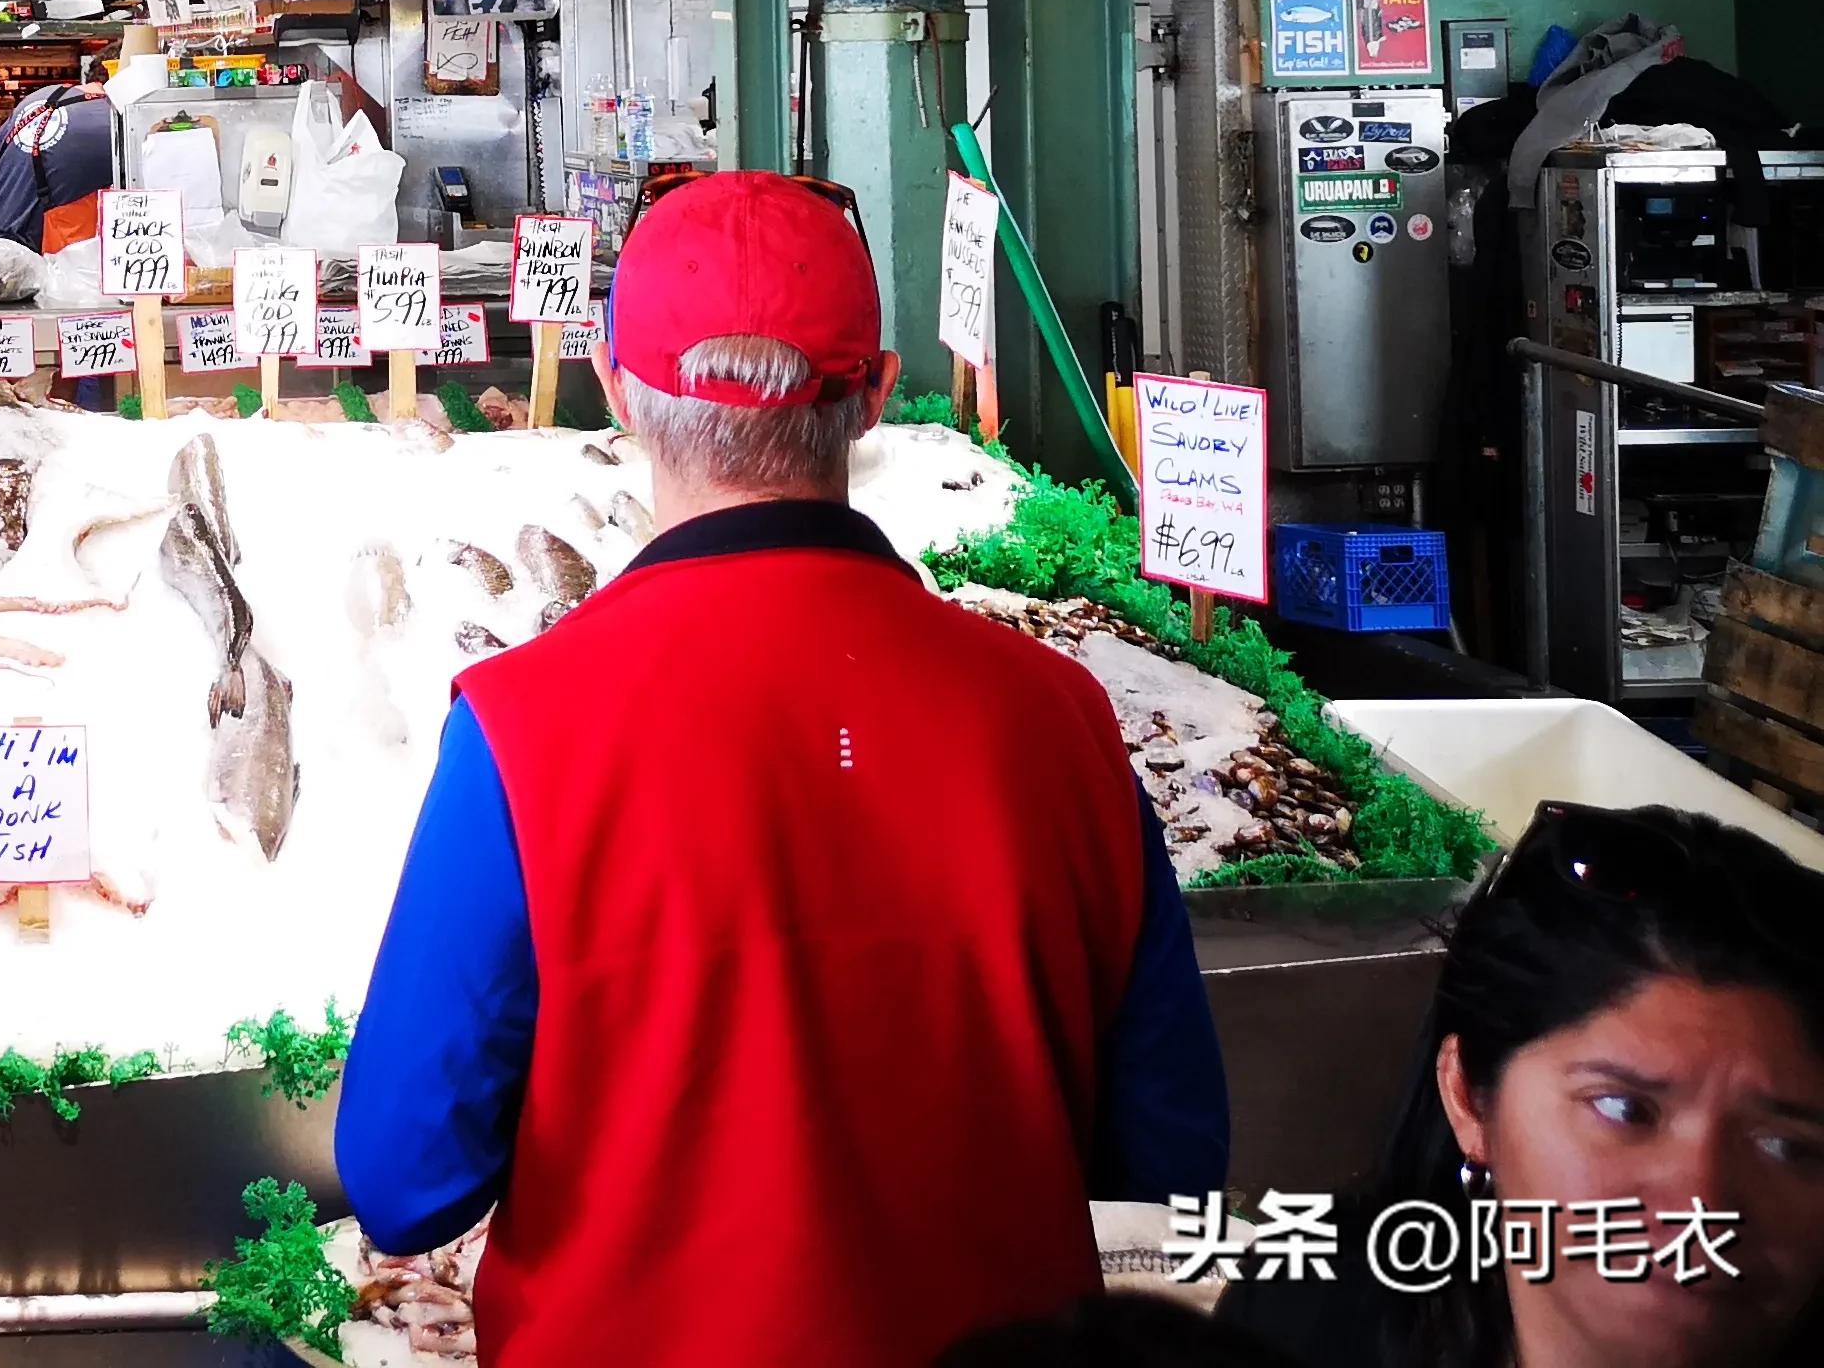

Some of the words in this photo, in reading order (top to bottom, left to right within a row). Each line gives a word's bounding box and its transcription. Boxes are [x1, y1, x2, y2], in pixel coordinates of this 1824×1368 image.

[1277, 29, 1344, 55] FISH
[1303, 178, 1374, 202] URUAPAN
[111, 218, 175, 240] BLACK
[125, 238, 163, 255] COD
[517, 231, 586, 260] RAINBOW
[518, 260, 580, 277] TROUT
[947, 240, 987, 280] MUSSELS
[360, 265, 435, 287] TILAPIA
[190, 313, 230, 330] MEDIUM
[252, 302, 294, 321] COD
[61, 331, 83, 344] SEA
[84, 326, 131, 342] SCALLOPS
[1144, 383, 1210, 419] WILD!
[1213, 395, 1261, 427] LIVE!
[1149, 421, 1249, 459] SAVORY
[1154, 457, 1242, 495] CLAMS
[1151, 511, 1235, 573] $6.99
[11, 773, 37, 801] A
